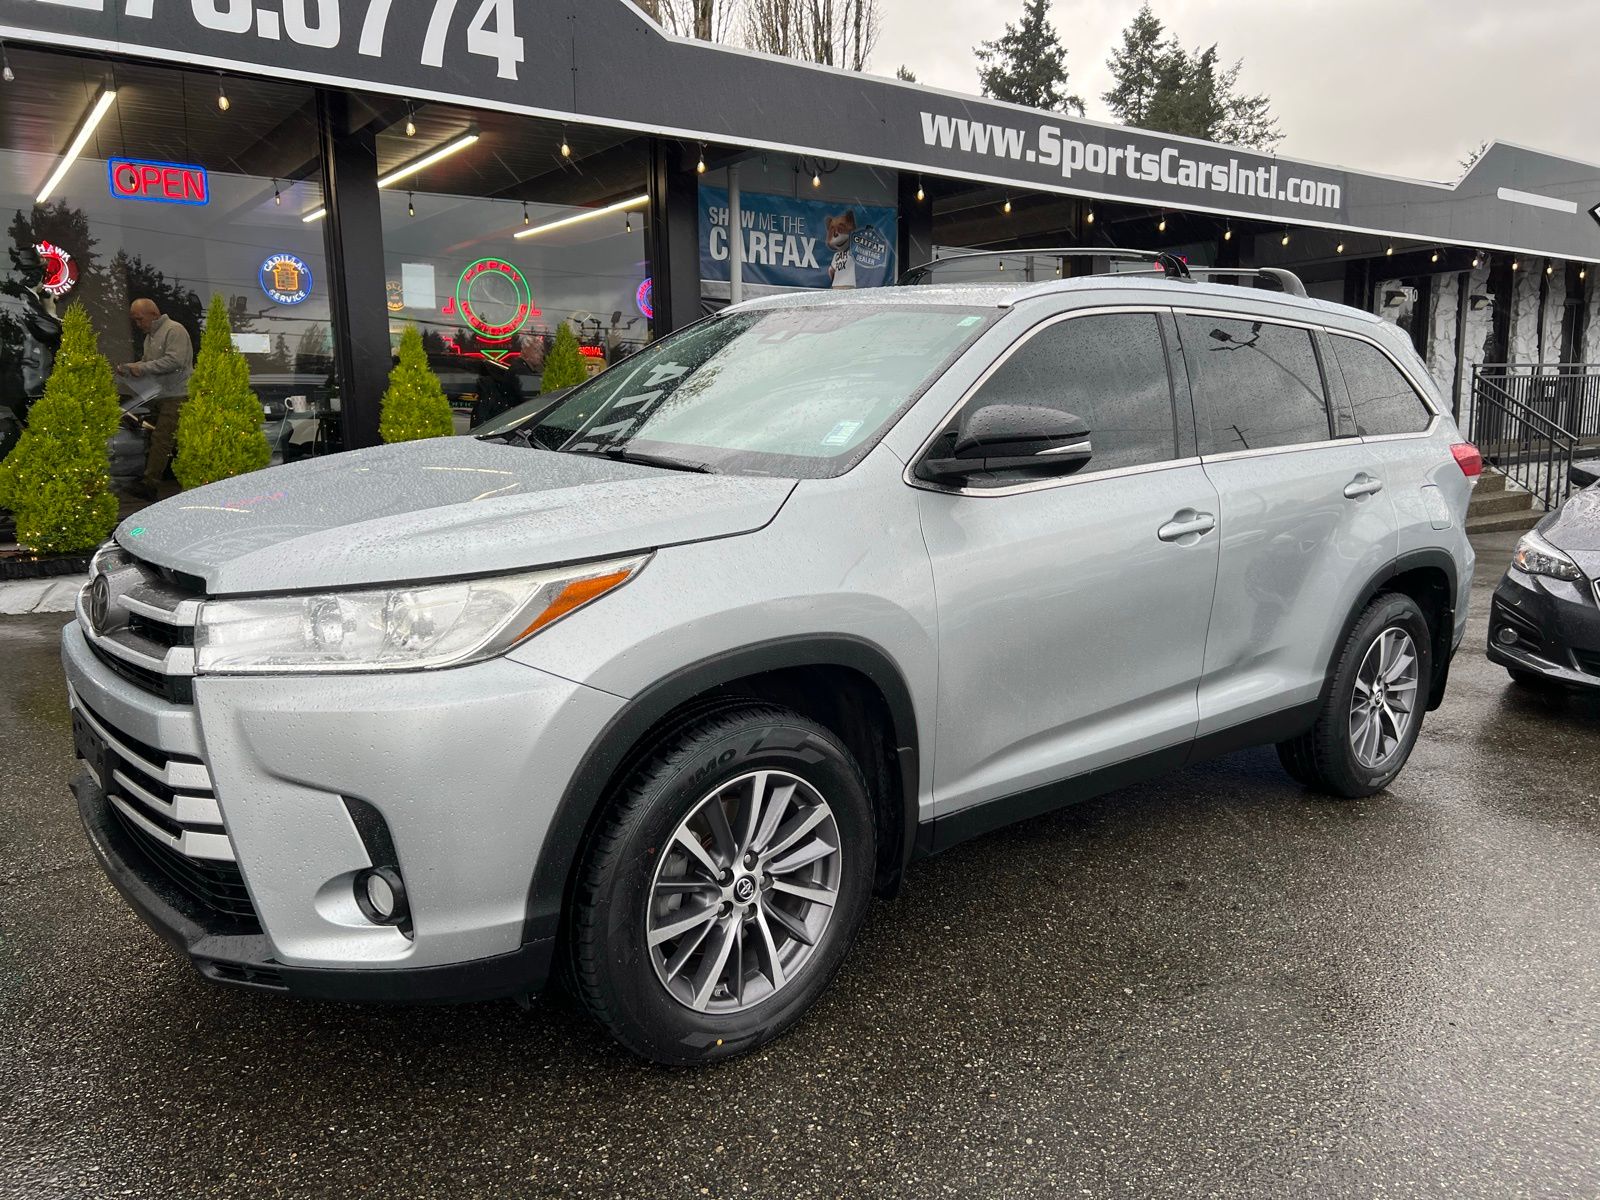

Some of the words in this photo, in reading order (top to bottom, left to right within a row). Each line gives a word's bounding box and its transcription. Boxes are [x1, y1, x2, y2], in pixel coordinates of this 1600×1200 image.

[920, 111, 1341, 209] www.SportsCarsIntl.com
[114, 163, 205, 200] OPEN
[709, 206, 755, 228] SHW
[759, 212, 778, 233] ME
[781, 215, 805, 235] THE
[264, 255, 307, 274] CADILLAC
[269, 289, 305, 303] SERVICE
